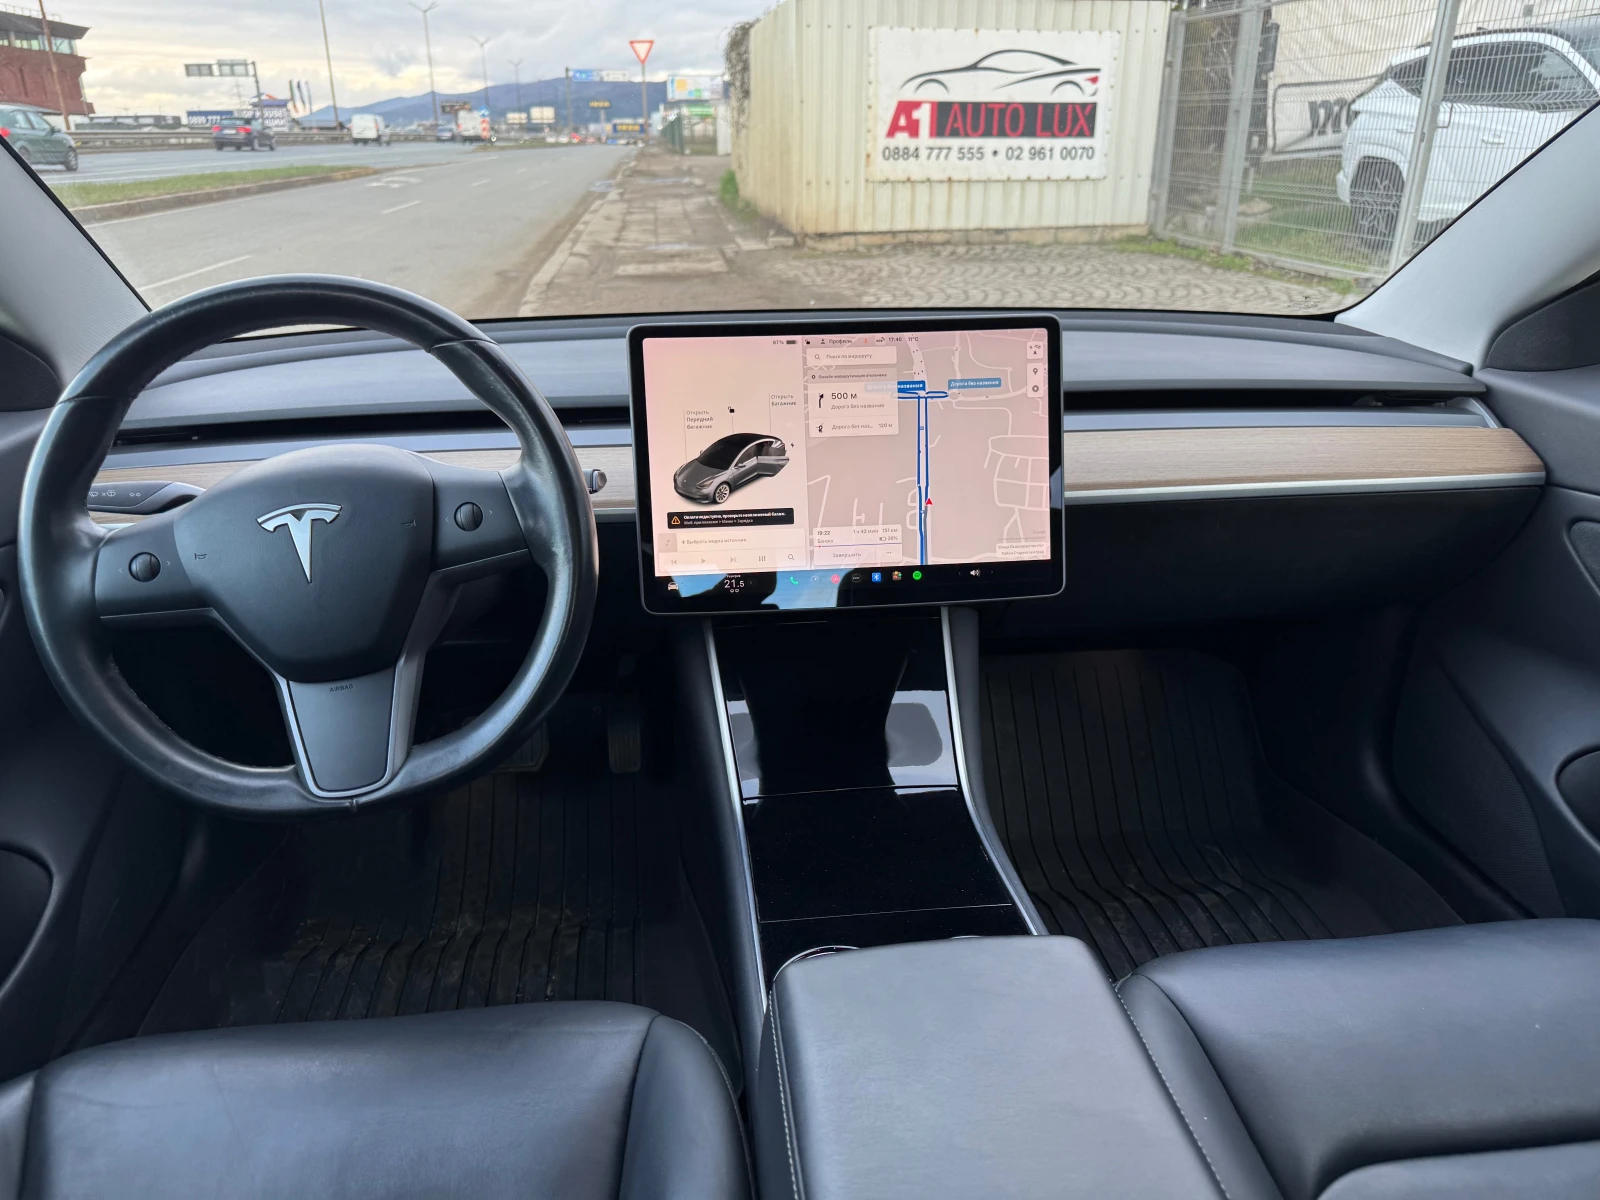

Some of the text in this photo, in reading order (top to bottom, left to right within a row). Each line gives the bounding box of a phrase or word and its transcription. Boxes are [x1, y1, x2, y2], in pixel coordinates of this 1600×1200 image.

[886, 101, 1094, 138] A1 AUTO LUX
[882, 146, 1095, 161] 0884 777 555 02 961 0070
[724, 580, 744, 588] 21.5
[330, 684, 353, 692] AIRBAG
